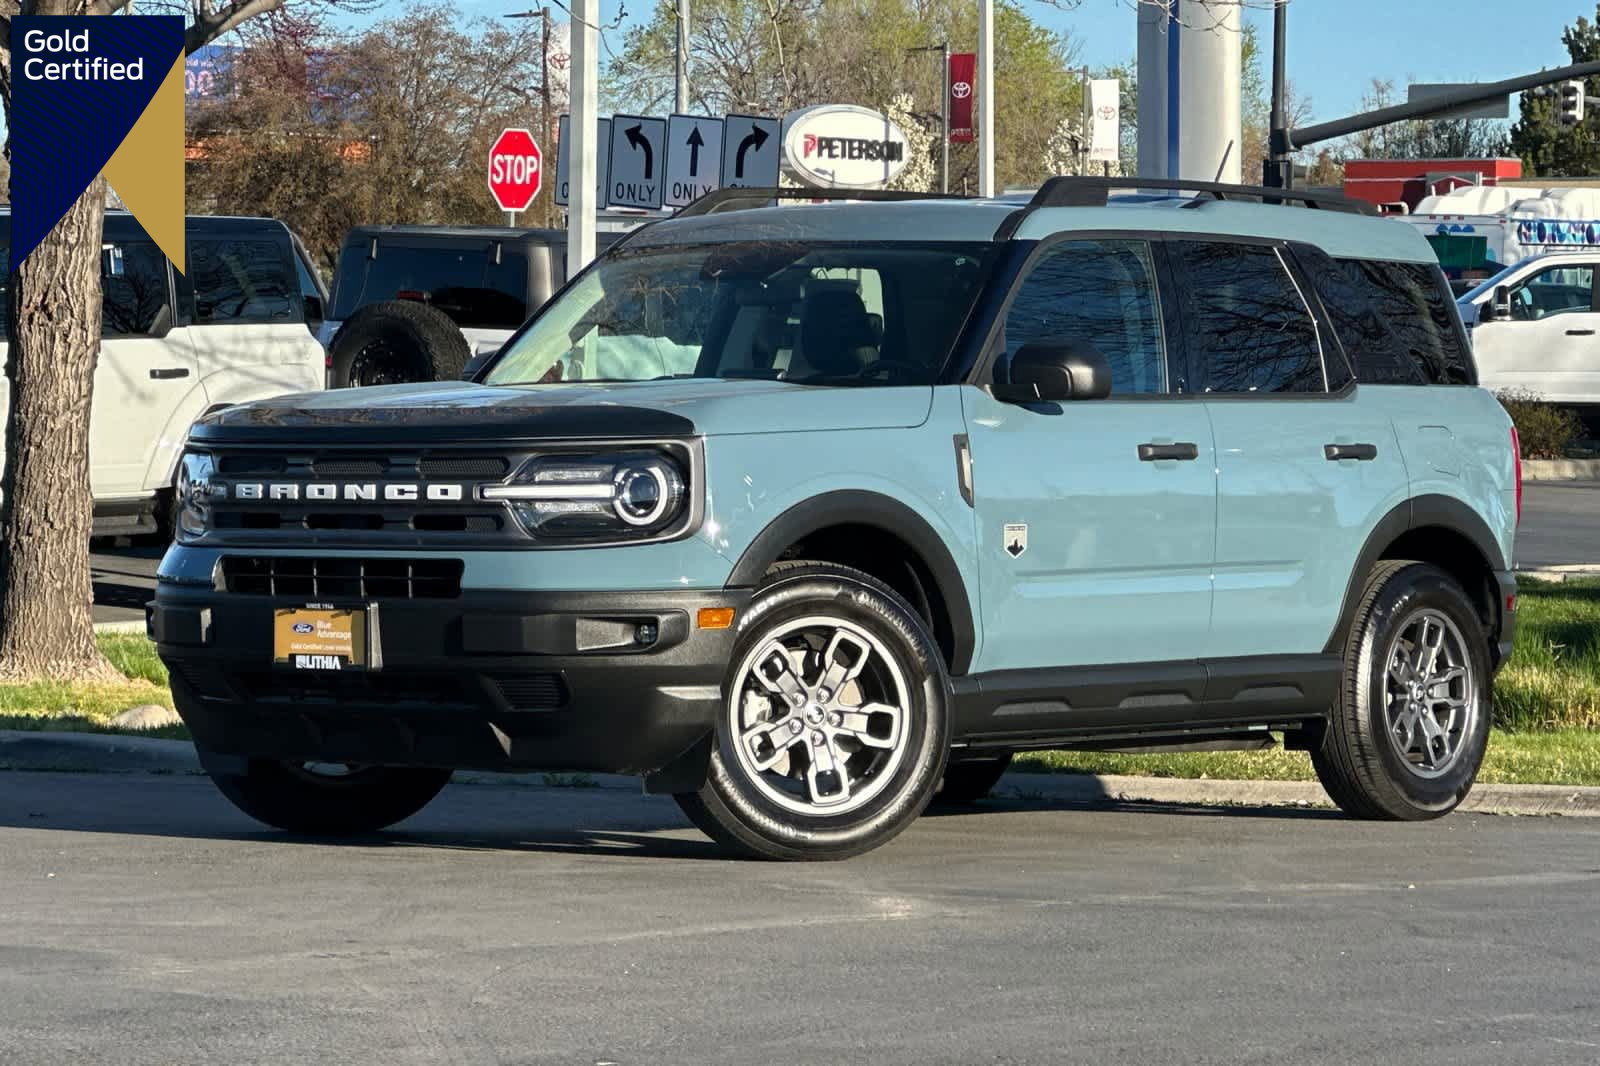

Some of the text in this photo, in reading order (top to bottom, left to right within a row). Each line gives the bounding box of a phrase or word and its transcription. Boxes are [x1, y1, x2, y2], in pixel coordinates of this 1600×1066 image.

[817, 136, 903, 162] PETERSON
[492, 153, 538, 185] STOP
[615, 182, 656, 201] ONLY
[235, 483, 463, 500] BRONCO
[306, 655, 341, 670] LITHIA
